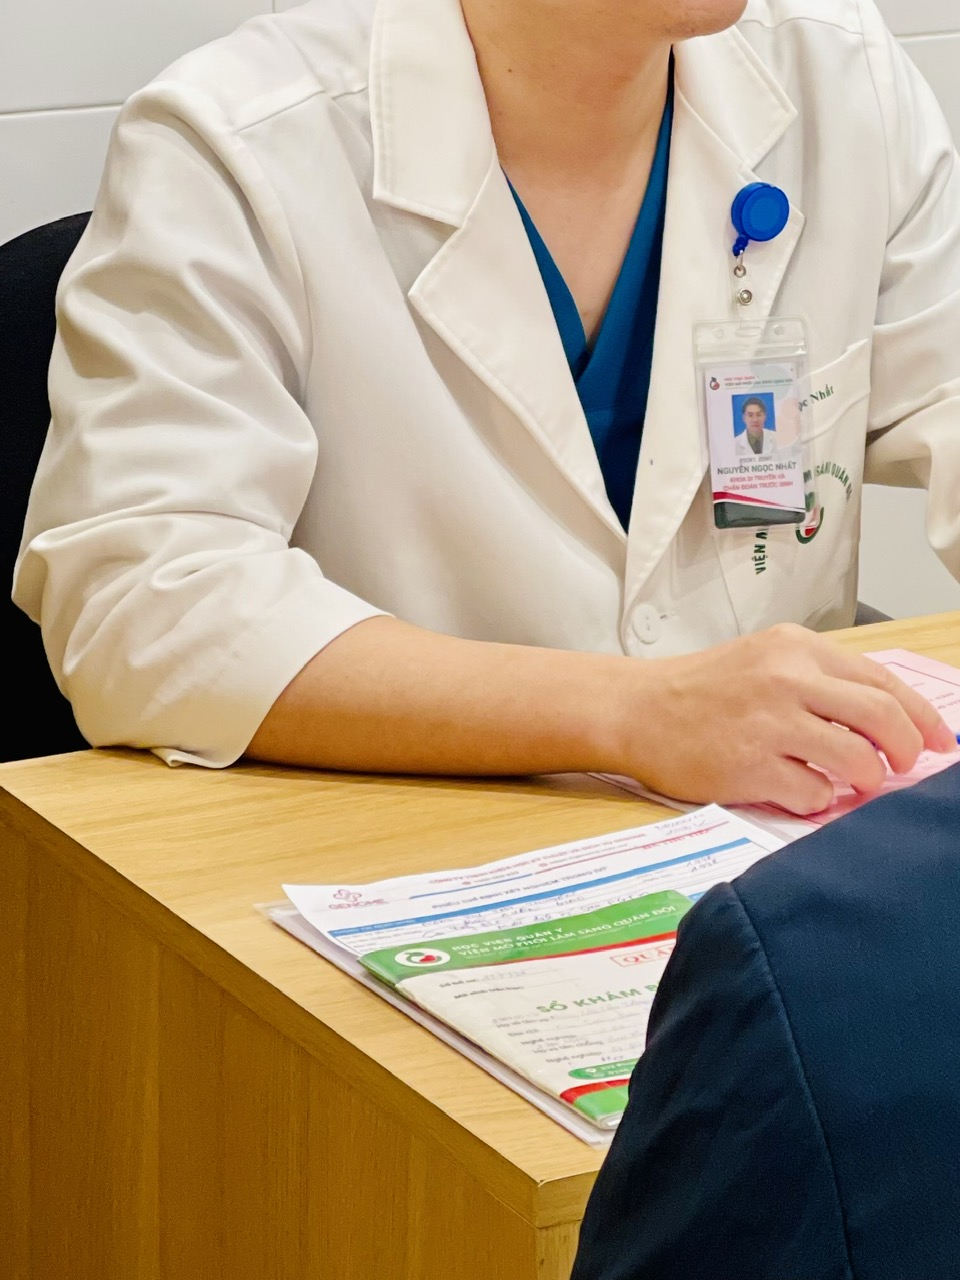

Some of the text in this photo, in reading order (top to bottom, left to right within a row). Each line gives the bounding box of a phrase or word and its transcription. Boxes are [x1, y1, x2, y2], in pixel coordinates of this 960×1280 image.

[751, 464, 774, 473] NGỌC
[751, 543, 769, 576] VIỆN
[536, 1000, 568, 1013] SỔ
[572, 988, 642, 1007] KHÁM
